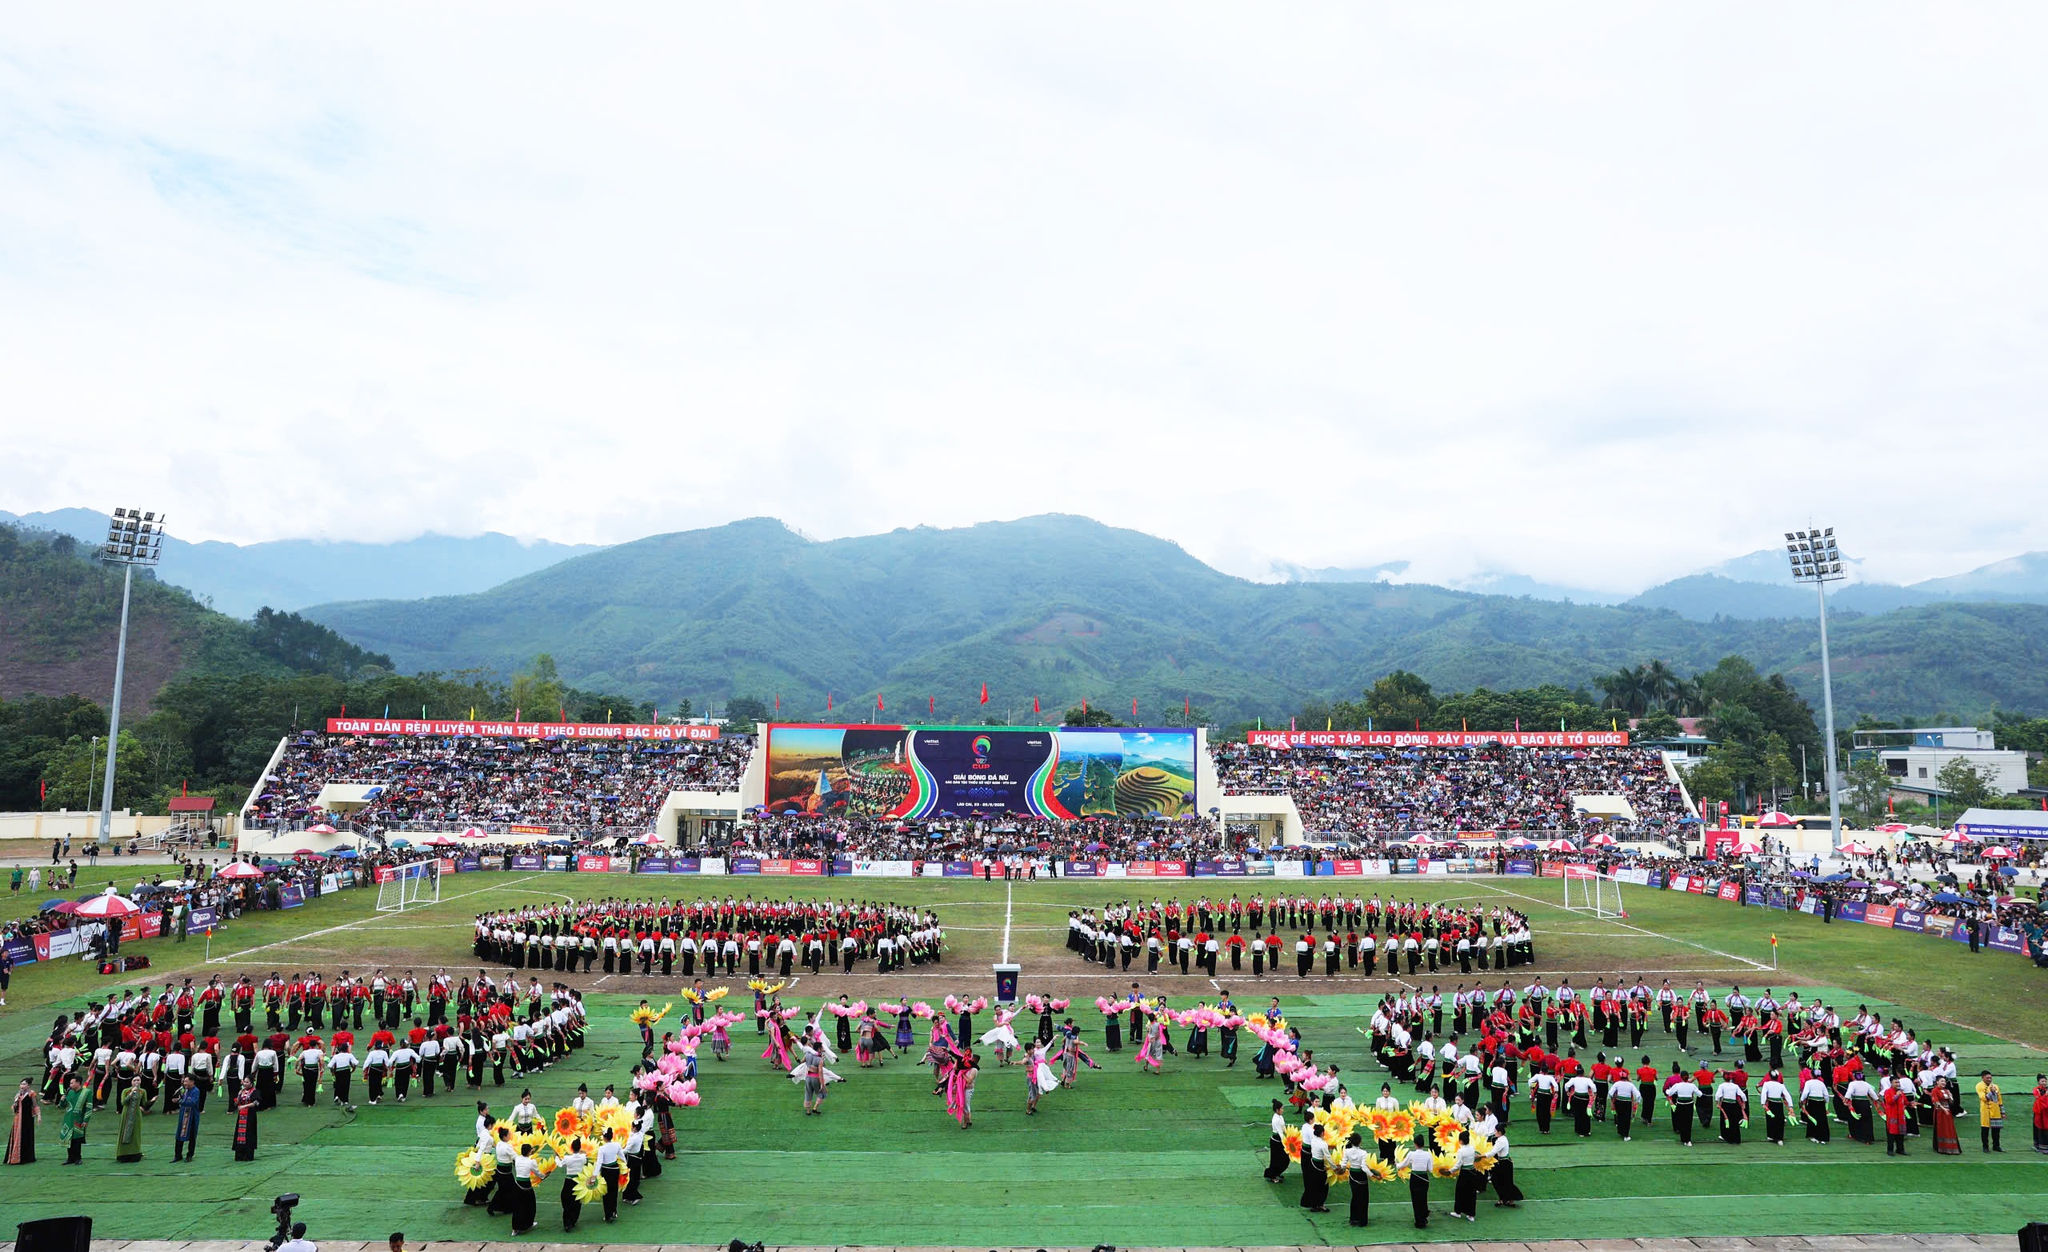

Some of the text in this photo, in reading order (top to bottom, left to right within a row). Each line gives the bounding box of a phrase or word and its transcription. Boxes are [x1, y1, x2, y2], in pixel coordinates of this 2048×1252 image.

[336, 720, 370, 732] TOÀN
[374, 721, 400, 732] DÂN
[405, 721, 430, 733] RÈN
[435, 721, 475, 735] LUYỆN
[480, 723, 513, 735] THÂN
[517, 722, 540, 735] THỂ
[544, 726, 575, 736] THEO
[578, 726, 622, 737] GƯƠNG
[625, 725, 650, 737] BÁC
[654, 725, 671, 738] HỒ
[690, 727, 712, 739] ĐẠI
[1290, 731, 1307, 744] ĐỂ
[1310, 734, 1336, 745] HỌC
[1369, 734, 1391, 744] LAO
[1437, 733, 1460, 744] XÂY
[1464, 734, 1498, 745] DỰNG
[1501, 733, 1517, 744] VÀ
[1520, 733, 1545, 744] BẢO
[1548, 733, 1564, 745] VỆ
[1568, 732, 1583, 744] TỔ
[1587, 732, 1621, 744] QUỐC
